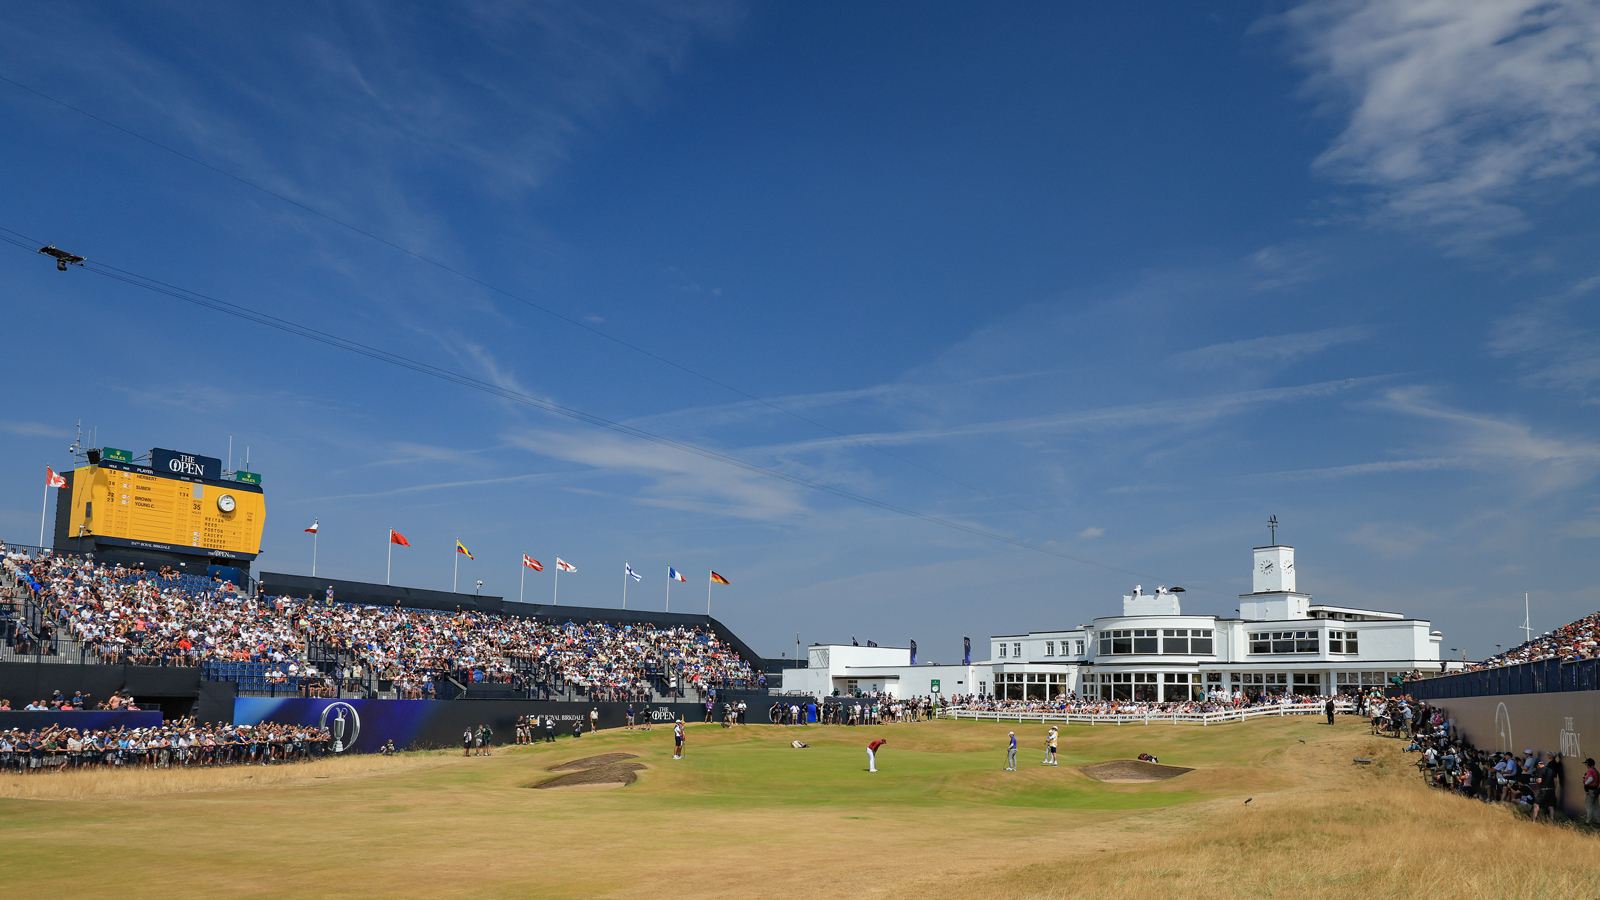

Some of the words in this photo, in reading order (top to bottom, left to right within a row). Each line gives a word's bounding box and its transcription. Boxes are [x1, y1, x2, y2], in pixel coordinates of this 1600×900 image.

[180, 454, 195, 464] THE
[169, 458, 205, 476] OPEN
[136, 474, 158, 482] HERBERT
[192, 503, 202, 511] 35
[651, 710, 675, 720] OPEN
[1564, 716, 1574, 731] THE
[1560, 729, 1580, 757] OPEN
